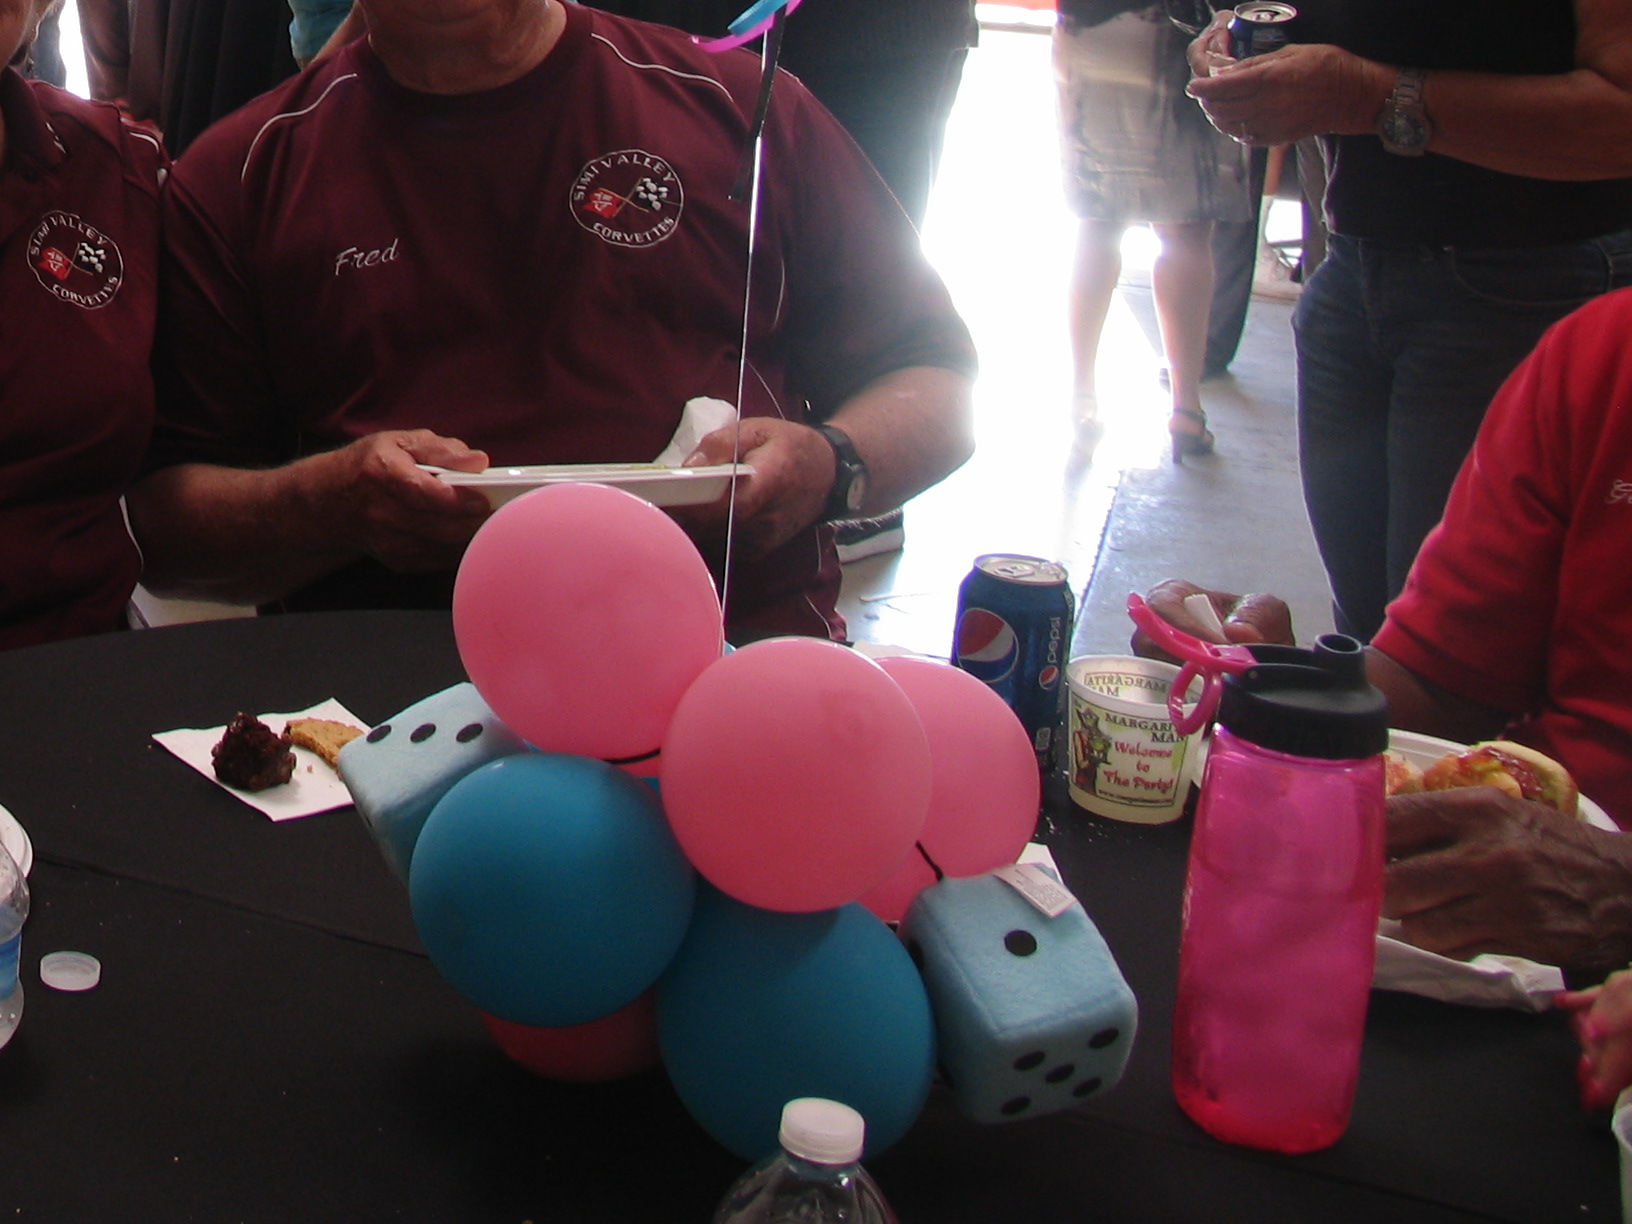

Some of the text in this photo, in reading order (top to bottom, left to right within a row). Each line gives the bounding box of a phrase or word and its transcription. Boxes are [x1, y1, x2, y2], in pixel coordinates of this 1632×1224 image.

[574, 154, 675, 201] SIMI VALLEY
[49, 215, 107, 245] VALLEY
[592, 216, 675, 243] CORVETTES
[335, 238, 400, 276] Fred
[52, 276, 118, 306] CORVETTES
[1105, 712, 1175, 732] MARGARI
[1115, 741, 1172, 758] Welcome
[1103, 770, 1130, 787] The
[1136, 760, 1150, 773] to
